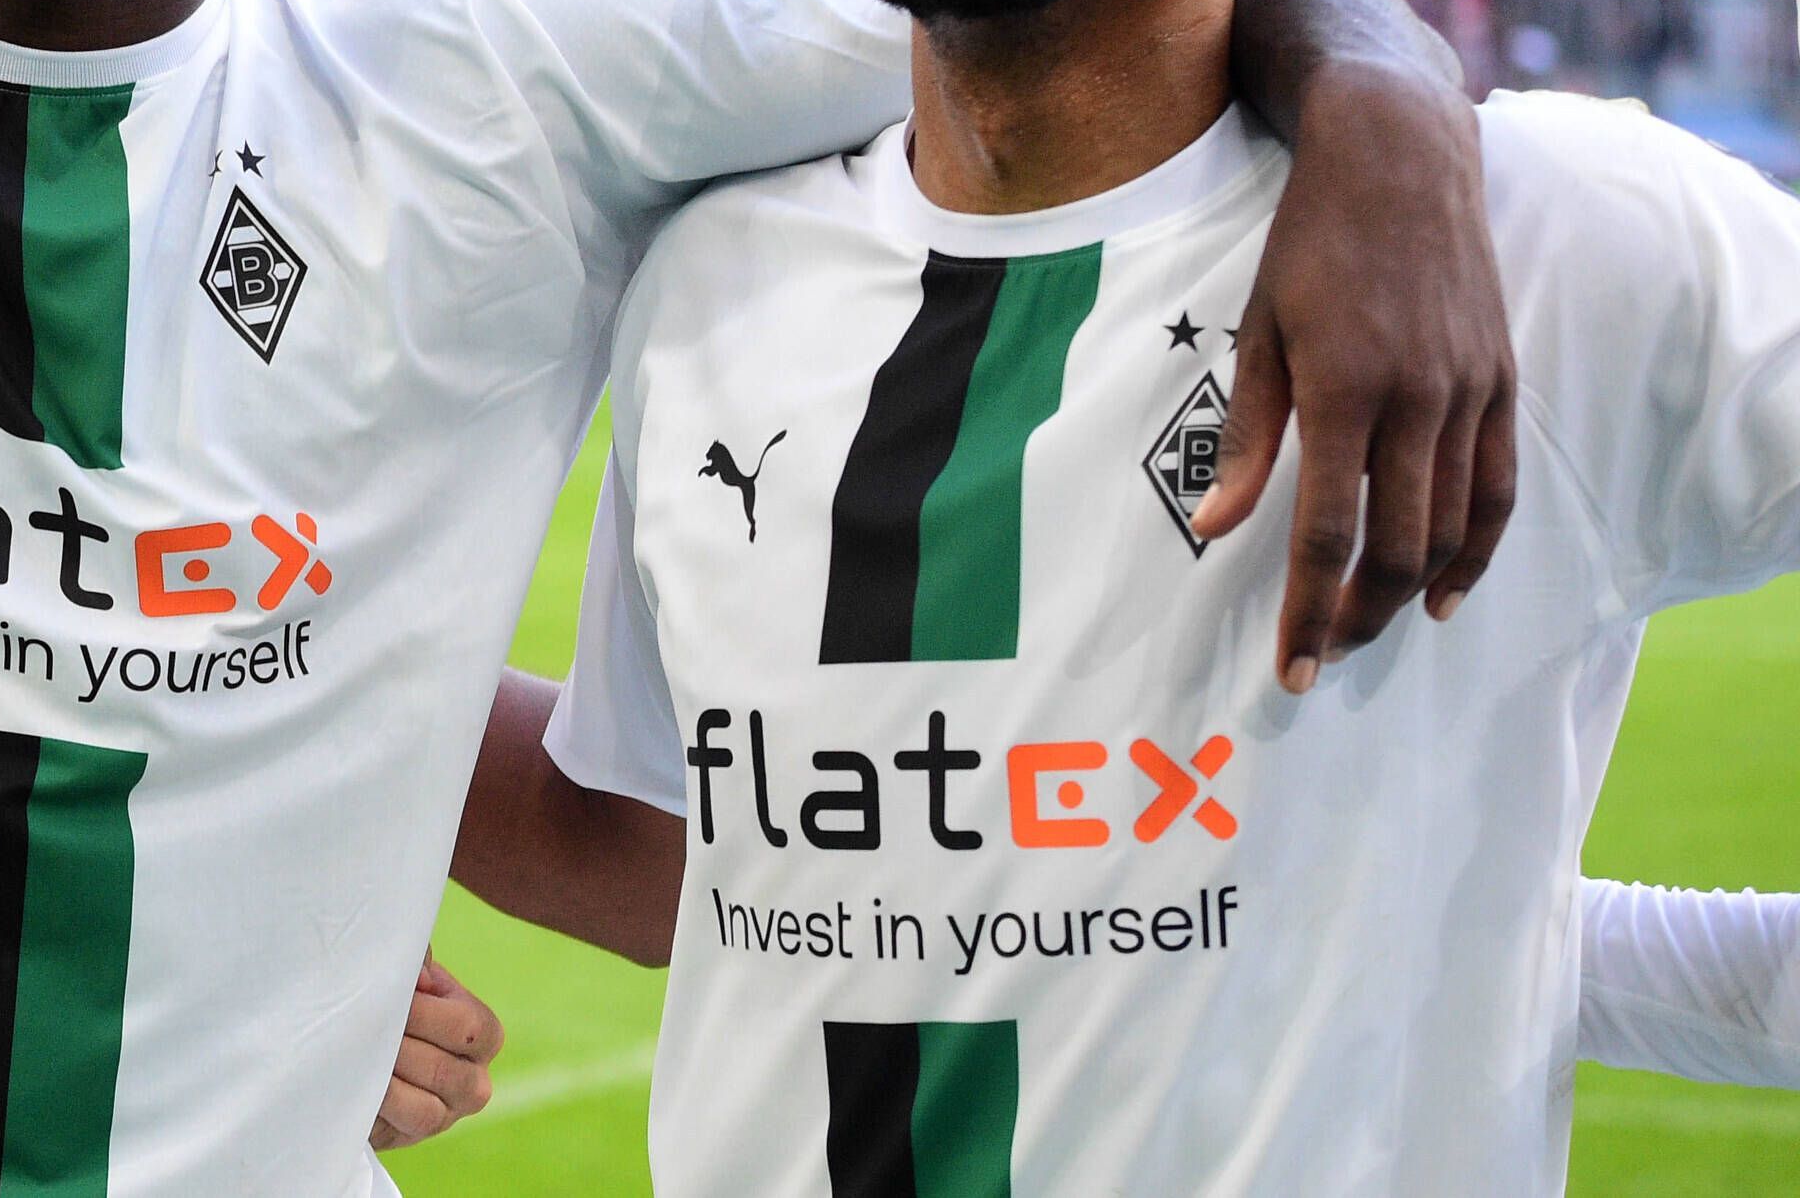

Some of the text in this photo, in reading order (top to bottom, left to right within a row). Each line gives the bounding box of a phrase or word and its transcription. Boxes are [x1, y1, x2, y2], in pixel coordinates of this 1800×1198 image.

[228, 242, 279, 311] B
[1, 620, 55, 681] in
[78, 620, 311, 702] yourself
[711, 885, 1239, 976] Invest in yourself
